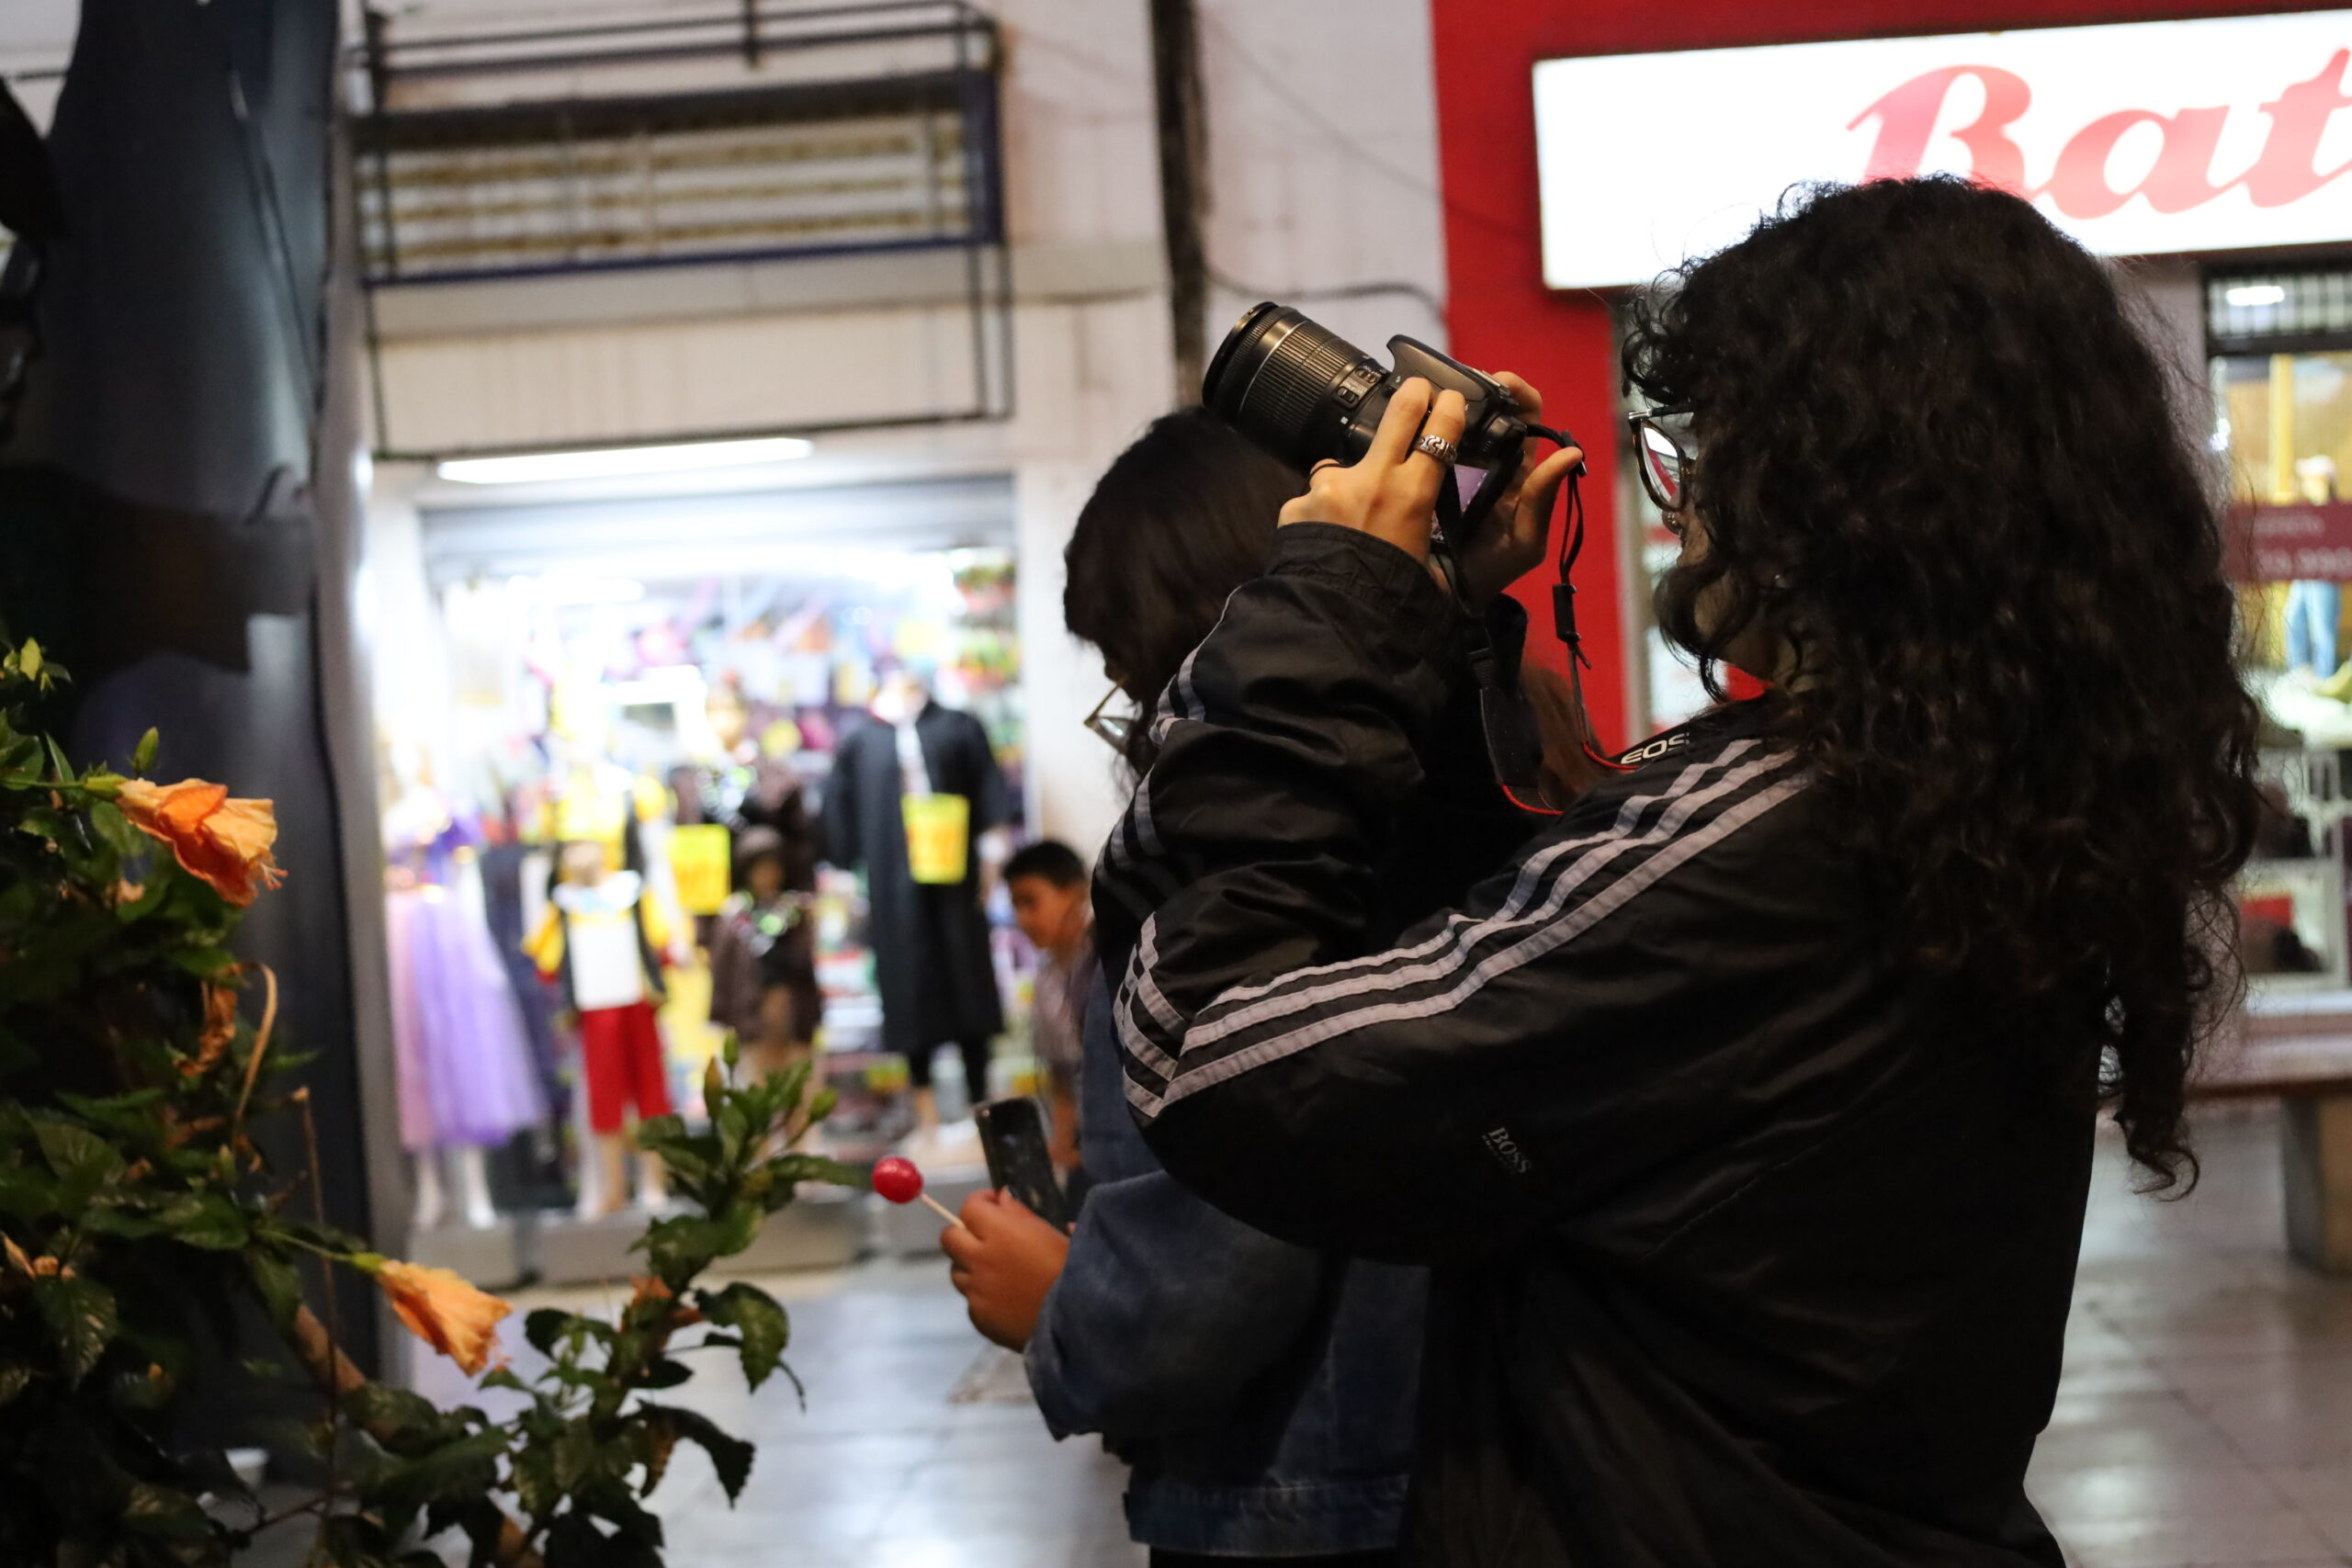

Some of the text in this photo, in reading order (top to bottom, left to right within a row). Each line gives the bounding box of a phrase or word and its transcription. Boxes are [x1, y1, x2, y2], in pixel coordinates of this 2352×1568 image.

[1847, 48, 2352, 220] Bat
[1620, 732, 1690, 764] EOS
[1488, 1126, 1532, 1173] BOSS
